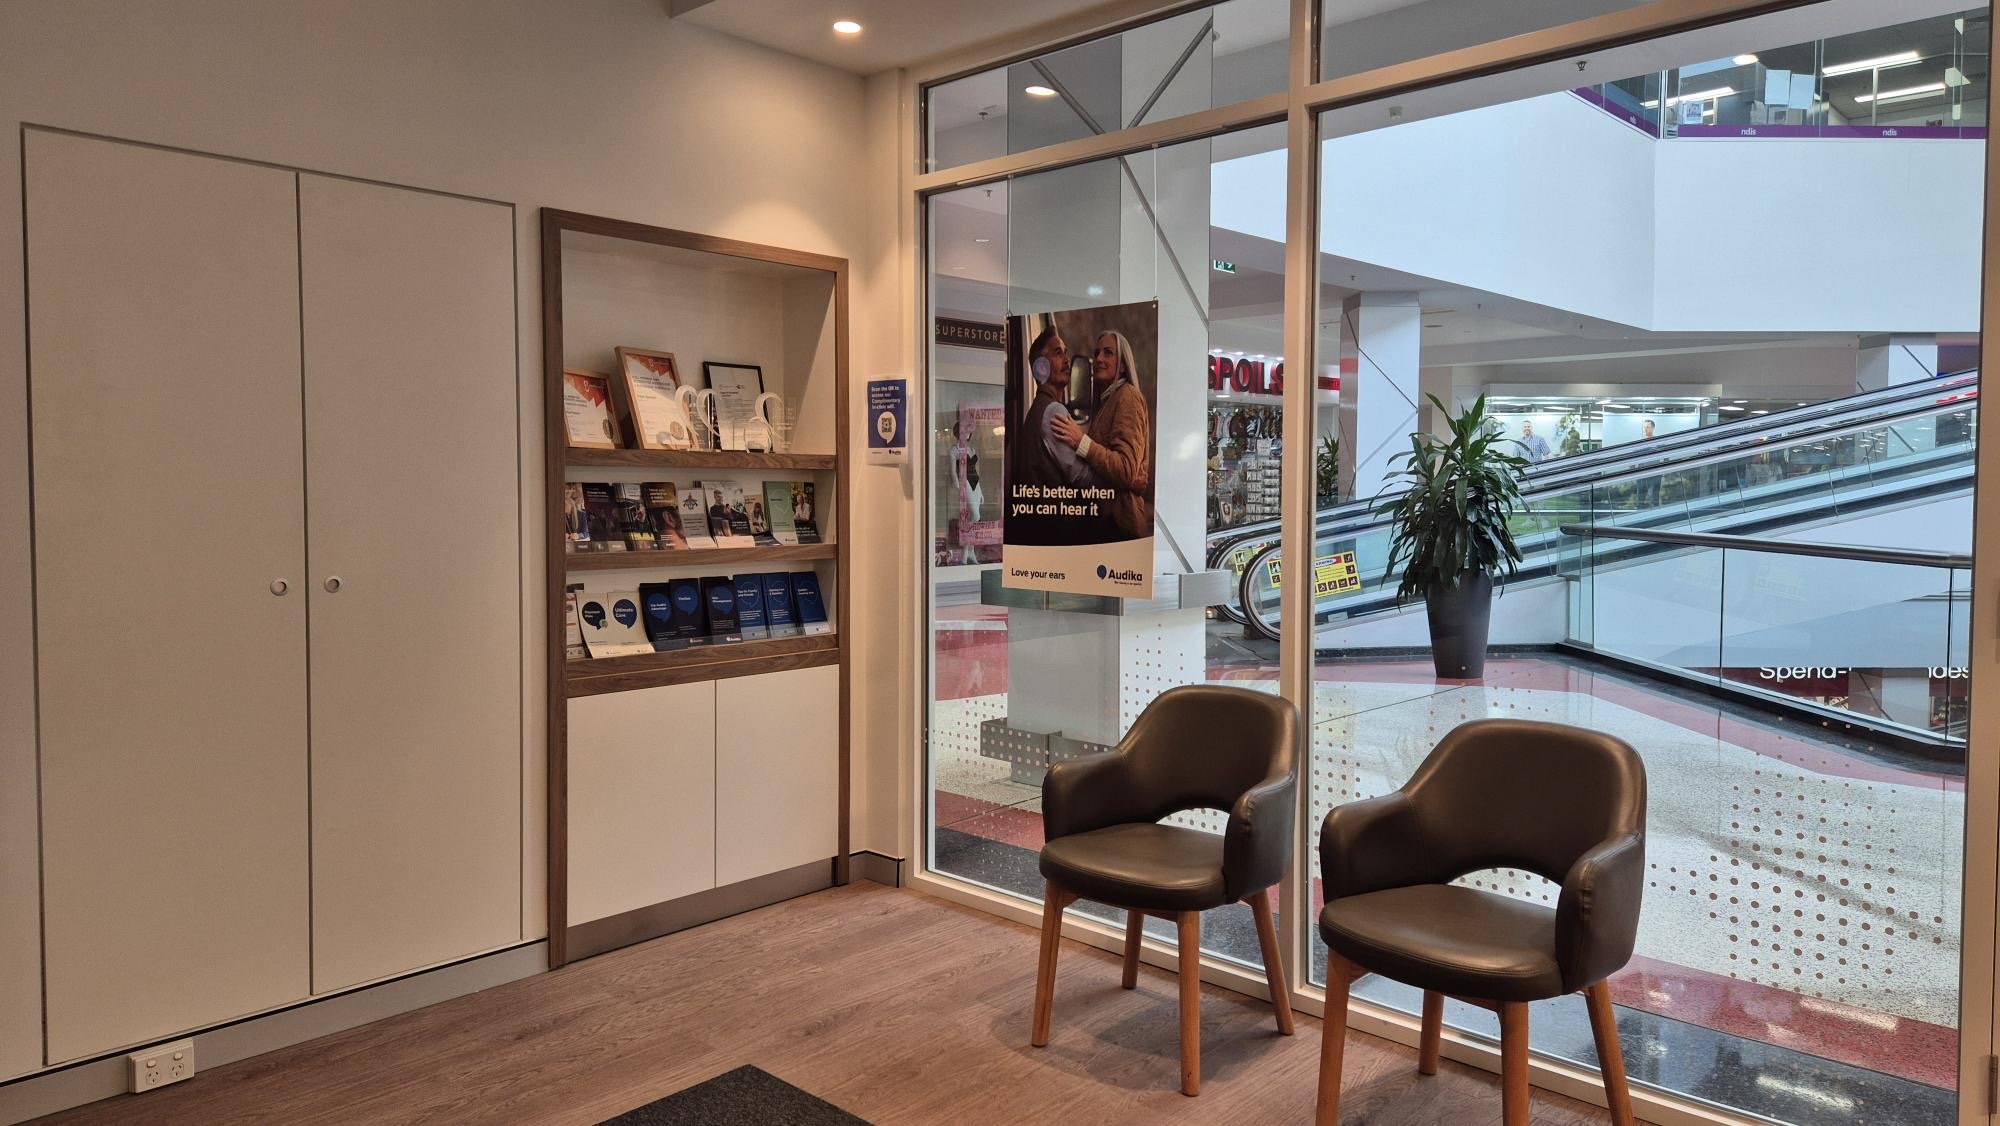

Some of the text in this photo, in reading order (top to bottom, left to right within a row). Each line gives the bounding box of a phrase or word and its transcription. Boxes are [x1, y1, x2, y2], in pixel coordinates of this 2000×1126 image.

[1740, 127, 1756, 136] ndis
[1882, 128, 1898, 137] ndis
[935, 324, 1005, 344] SUPERSTORE
[1043, 484, 1079, 499] better
[1081, 485, 1115, 499] when
[1012, 501, 1099, 517] you can hear it
[1011, 567, 1066, 580] Love your ears
[1108, 569, 1143, 582] Audika
[1759, 667, 1852, 683] Spend-
